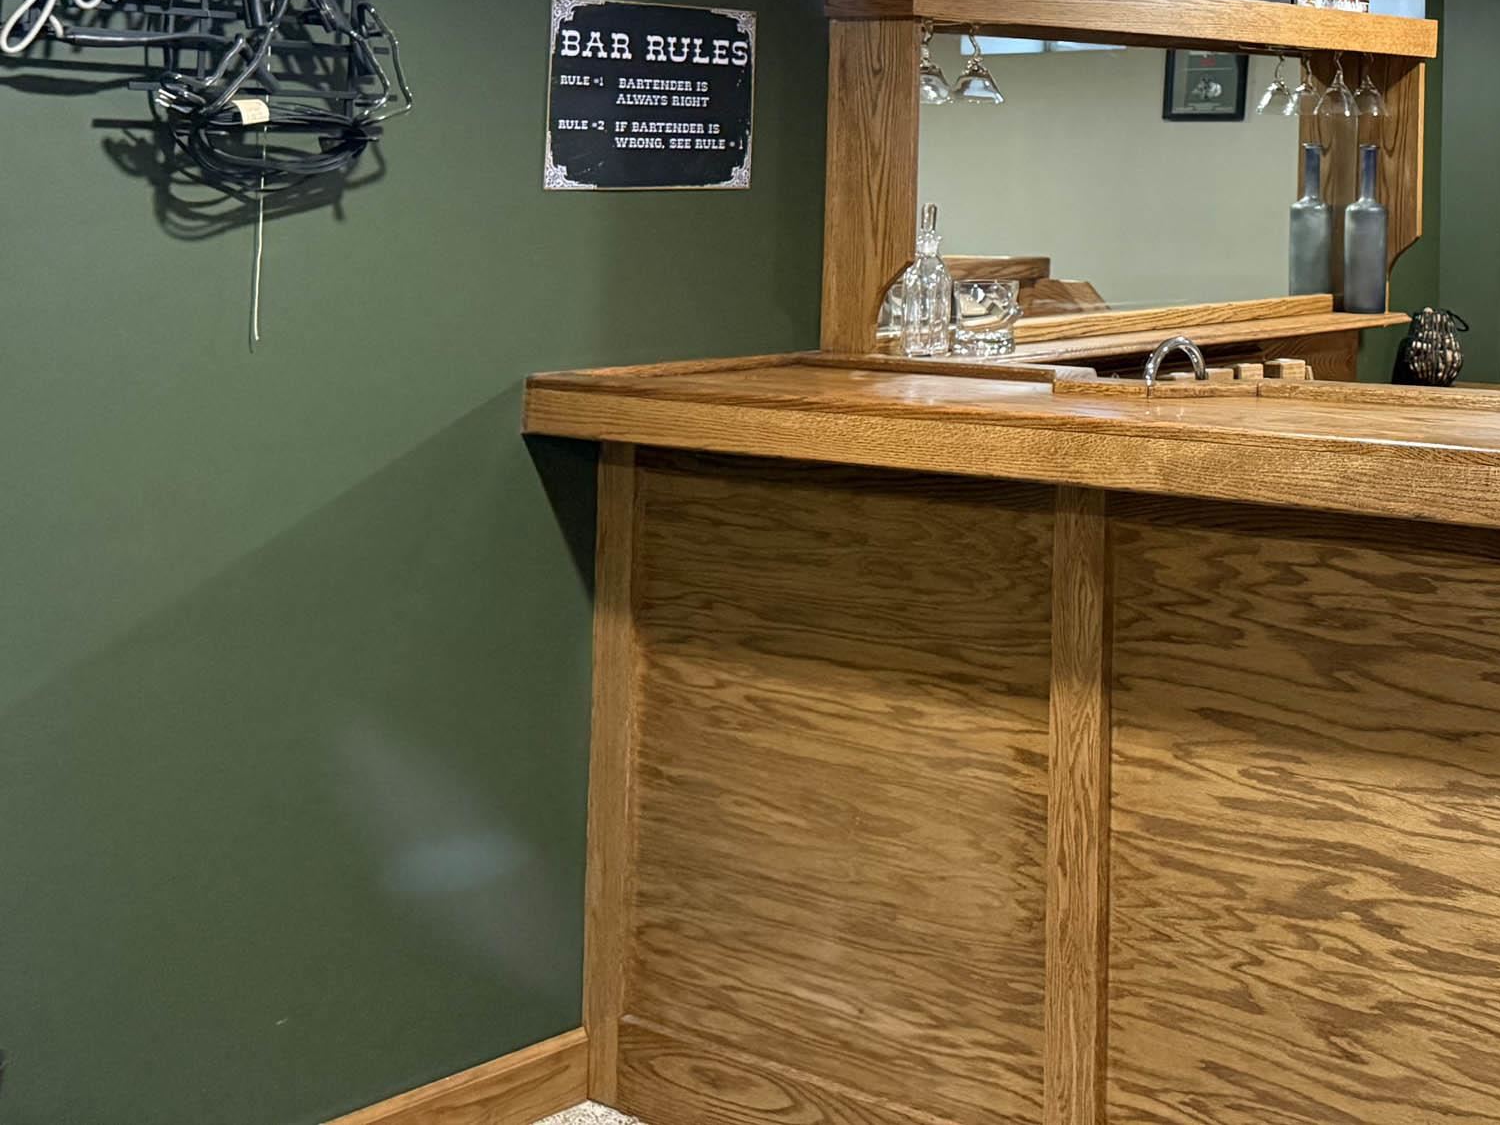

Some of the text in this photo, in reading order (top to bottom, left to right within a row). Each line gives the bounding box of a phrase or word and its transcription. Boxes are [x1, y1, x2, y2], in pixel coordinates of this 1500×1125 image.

[560, 29, 749, 66] BAR RULES
[560, 74, 590, 86] RULE
[619, 77, 693, 92] BARTENDER
[696, 81, 709, 92] IS
[616, 93, 710, 108] ALWAYS RIGHT
[558, 119, 588, 130] RULE
[615, 121, 628, 132] IF
[632, 122, 704, 135] BARTENDER
[709, 124, 720, 135] IS
[615, 137, 665, 150] WRONG,
[669, 138, 691, 150] SEE
[695, 138, 726, 150] RULE
